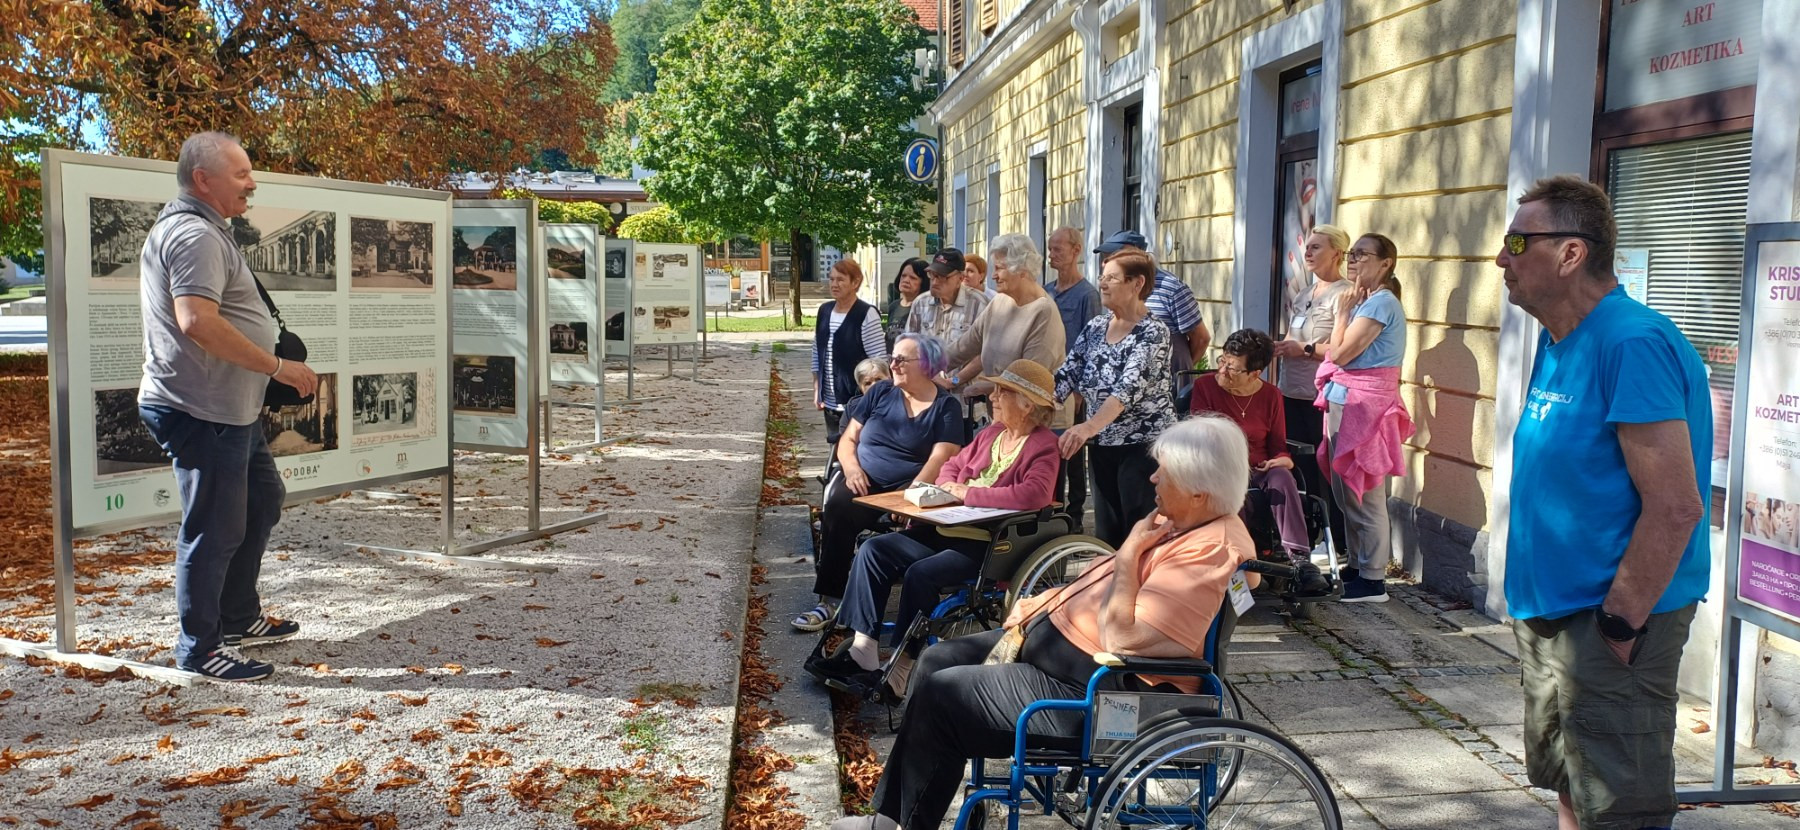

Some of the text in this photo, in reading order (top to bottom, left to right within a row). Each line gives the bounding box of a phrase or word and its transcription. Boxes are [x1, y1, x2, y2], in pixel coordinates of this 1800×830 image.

[1682, 3, 1716, 27] ART
[1649, 37, 1744, 75] KOZMETIKA
[1776, 393, 1799, 408] ART
[105, 493, 124, 512] 10
